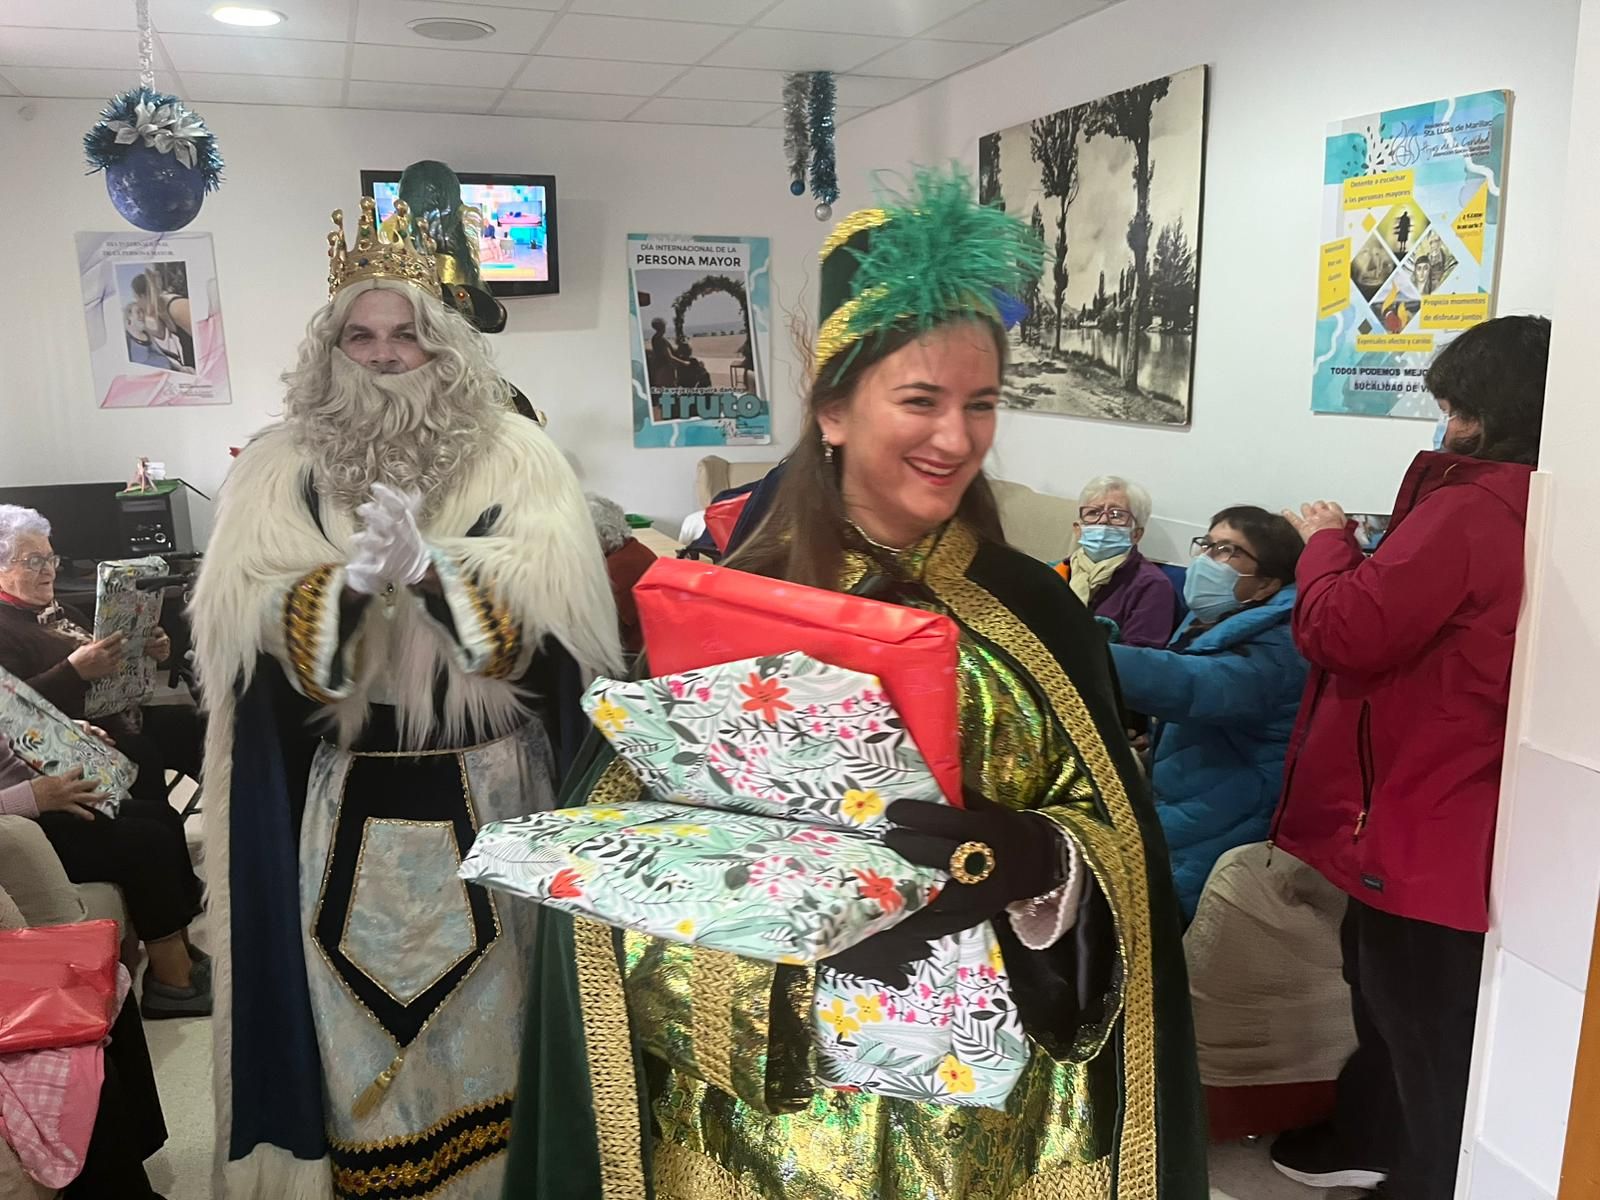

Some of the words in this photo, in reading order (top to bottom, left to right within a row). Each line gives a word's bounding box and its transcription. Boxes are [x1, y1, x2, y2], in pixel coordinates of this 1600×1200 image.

[1455, 123, 1465, 132] de
[641, 243, 654, 251] DÍA
[655, 244, 715, 253] INTERNACIONAL
[715, 246, 726, 254] DE
[727, 246, 737, 254] LA
[636, 254, 696, 266] PERSONA
[698, 256, 742, 268] MAYOR
[1330, 367, 1357, 375] TODOS
[1359, 367, 1401, 377] PODEMOS
[1406, 384, 1418, 392] DE
[658, 391, 761, 420] fruto
